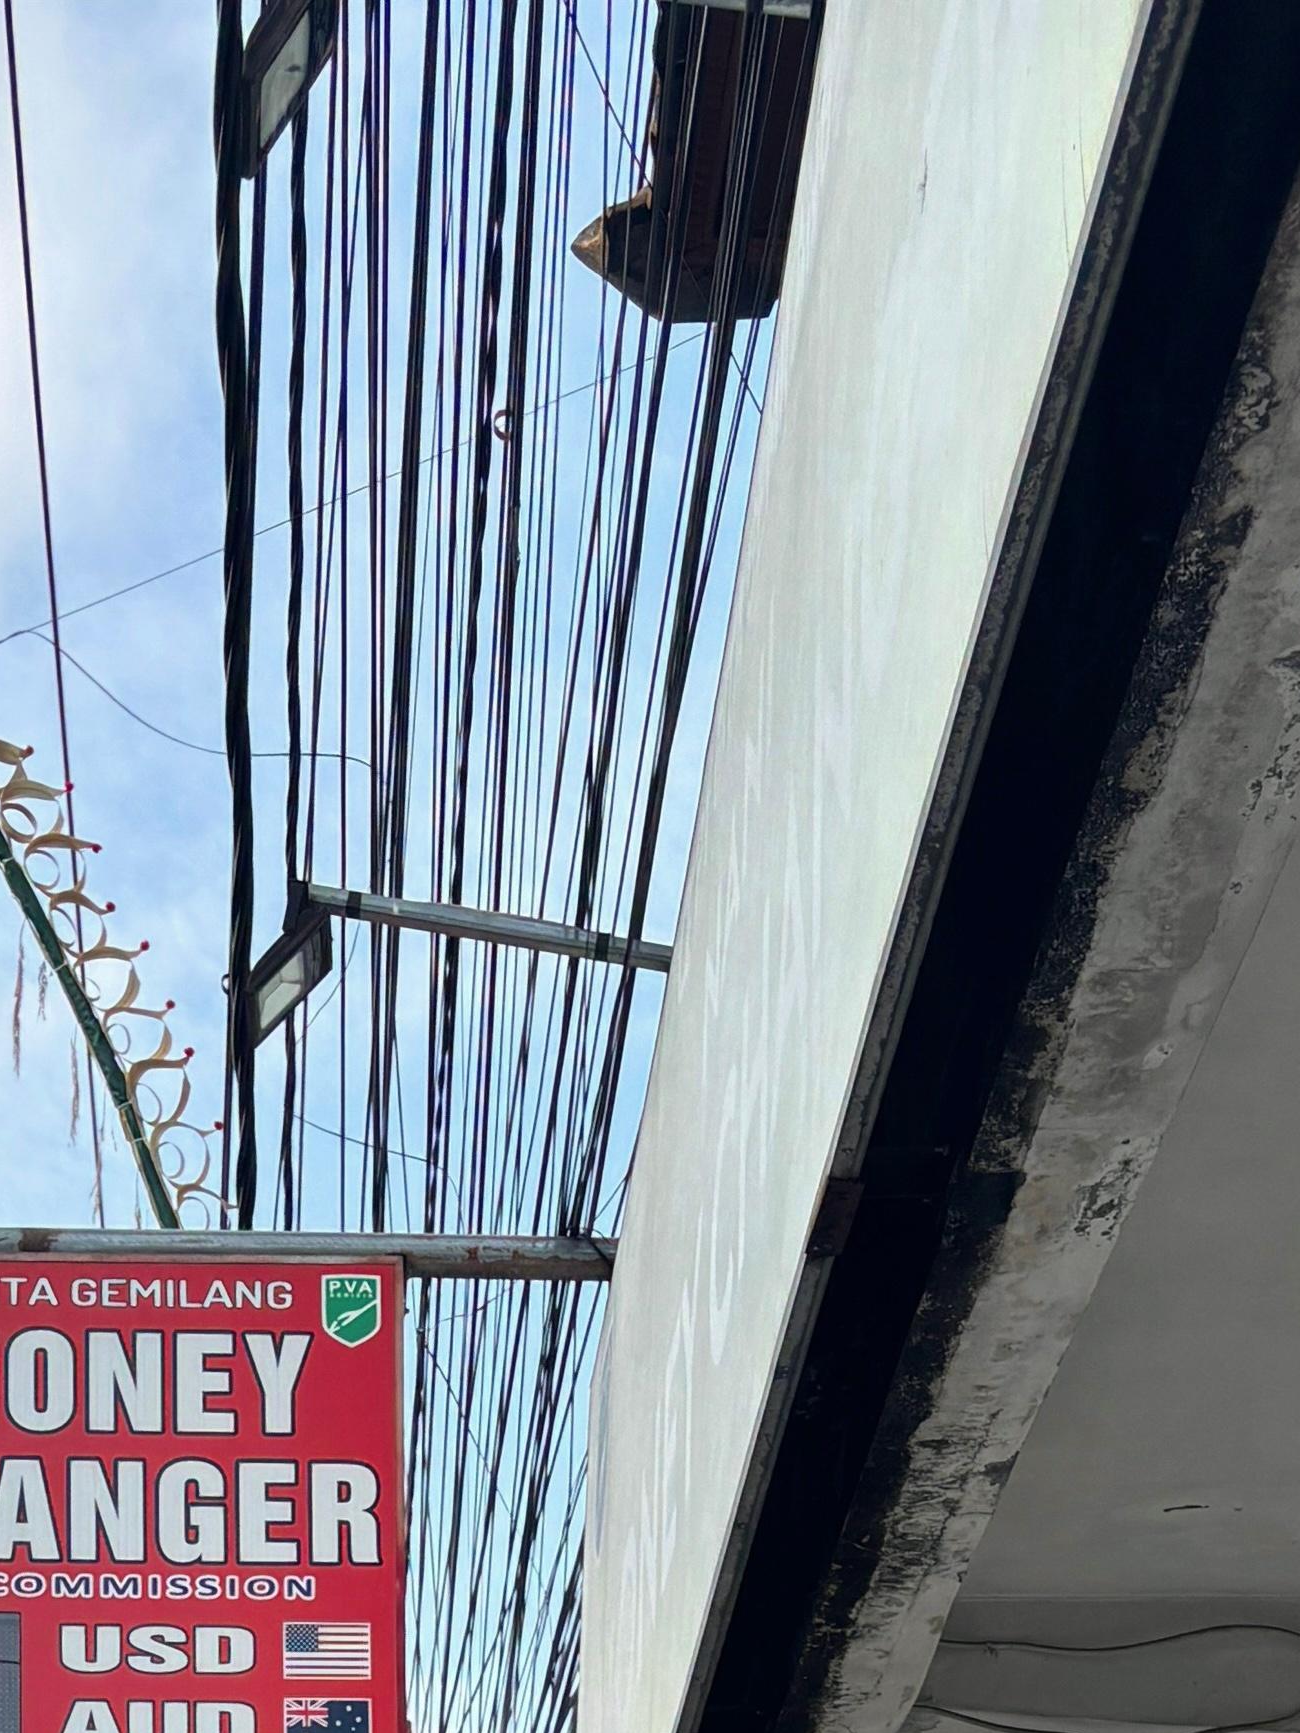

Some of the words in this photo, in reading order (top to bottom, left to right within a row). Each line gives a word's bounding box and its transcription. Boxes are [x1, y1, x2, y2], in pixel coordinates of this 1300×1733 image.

[71, 1278, 293, 1310] GEMILANG
[329, 1280, 373, 1294] PVA
[60, 1623, 256, 1676] USD
